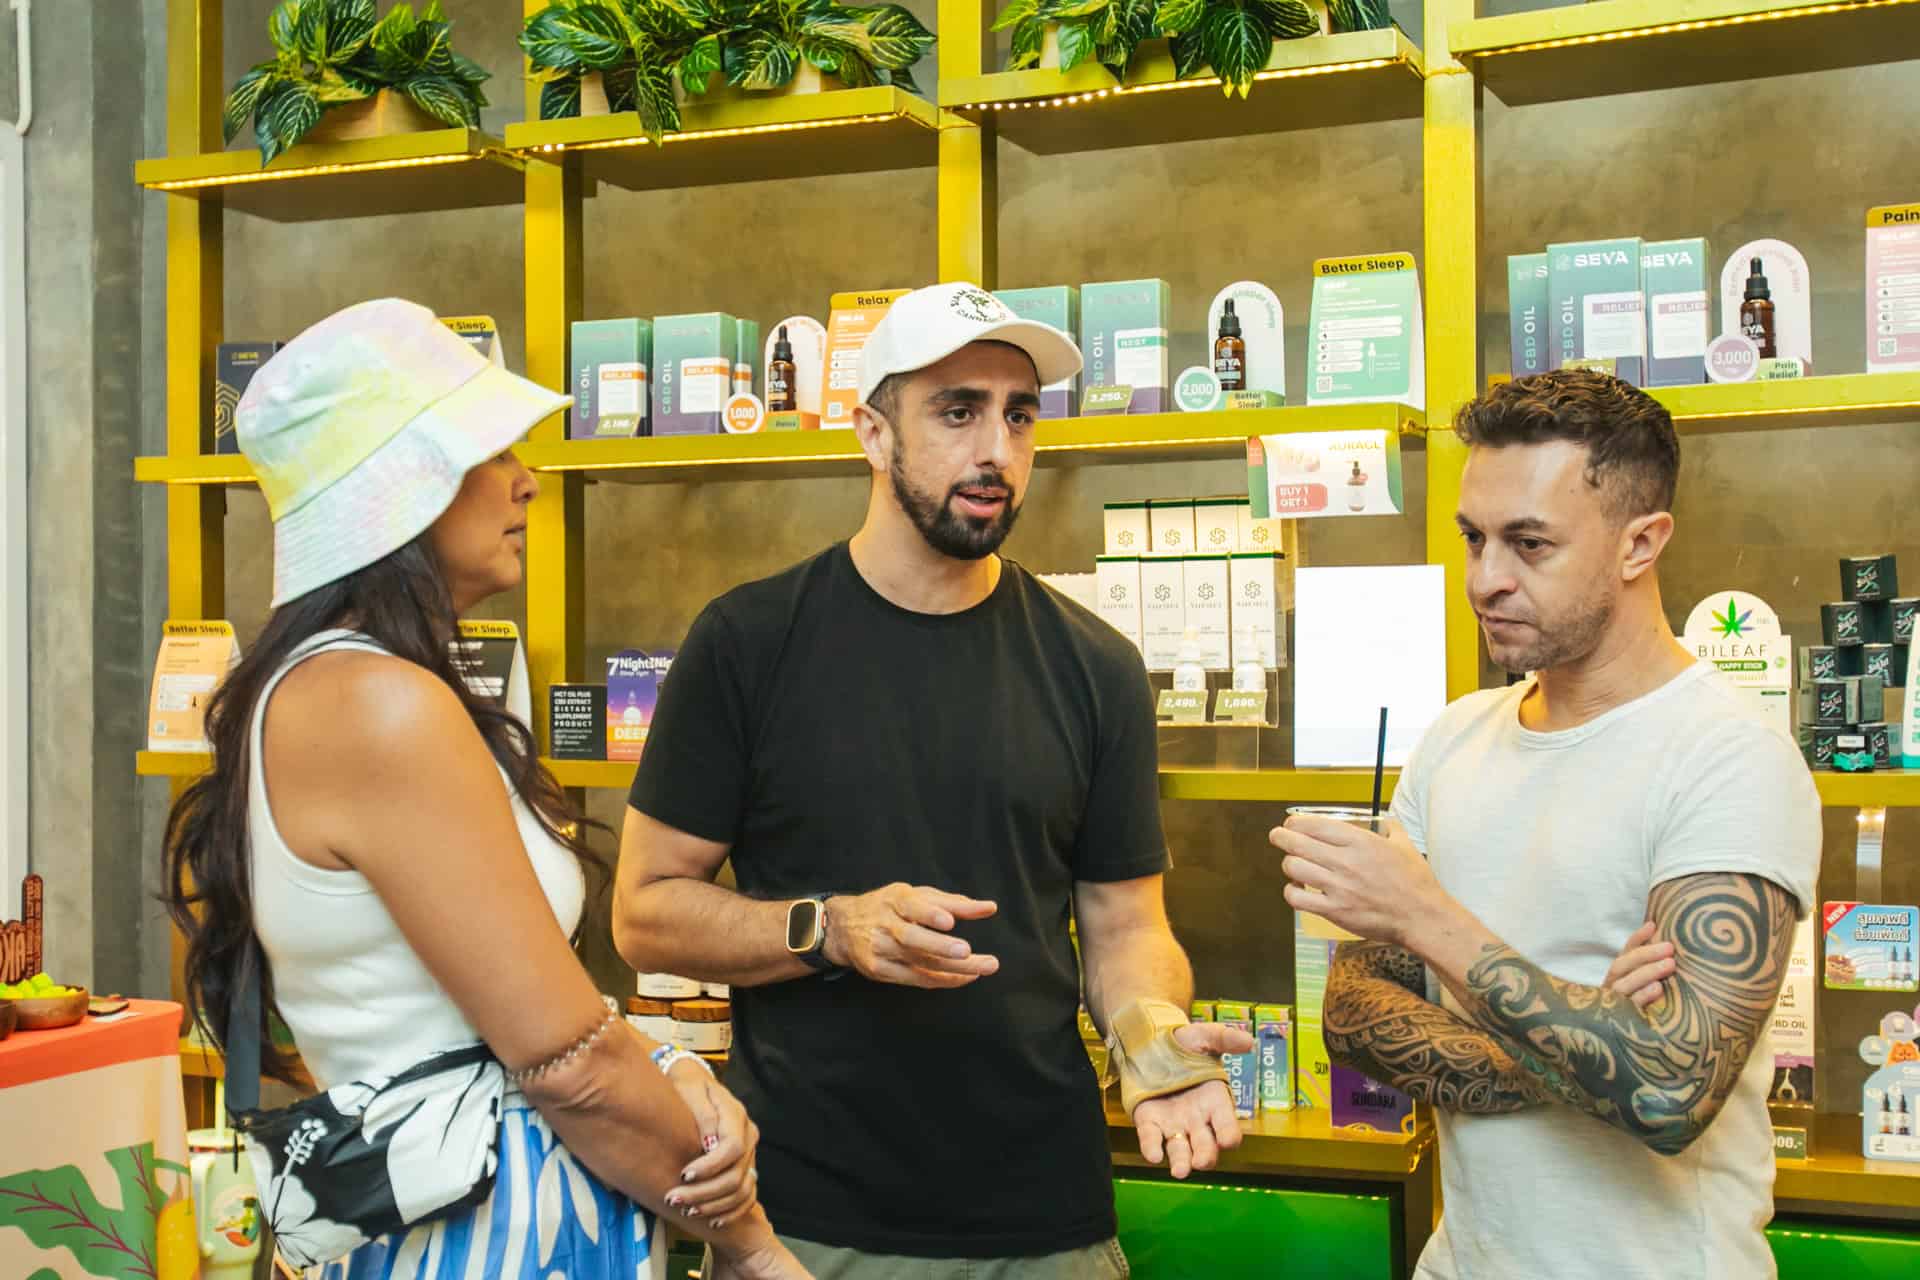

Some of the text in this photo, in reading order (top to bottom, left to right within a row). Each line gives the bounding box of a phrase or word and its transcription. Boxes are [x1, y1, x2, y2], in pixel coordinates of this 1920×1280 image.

[1883, 209, 1920, 224] Pain
[1321, 258, 1405, 274] Better Sleep
[857, 296, 890, 306] Relax
[1562, 295, 1574, 325] OIL
[456, 321, 487, 335] Sleep
[1092, 330, 1104, 358] OIL
[1523, 305, 1537, 369] CBD OIL
[1775, 361, 1798, 370] Pain
[1768, 370, 1798, 380] Relief
[580, 363, 591, 420] CBD OIL
[662, 360, 673, 415] CBD OIL
[1234, 391, 1263, 400] Better
[1237, 400, 1263, 409] Sleep
[1279, 486, 1302, 495] BUY
[1279, 498, 1302, 507] GET
[168, 625, 226, 637] Better Sleep
[480, 625, 510, 636] Sleep
[1698, 644, 1768, 657] BILEAF
[607, 656, 619, 676] 7
[1827, 904, 1847, 924] NEW
[1791, 1020, 1809, 1030] OIL
[1263, 1043, 1275, 1066] OIL
[1231, 1055, 1243, 1077] OIL
[1264, 1070, 1276, 1097] CBD
